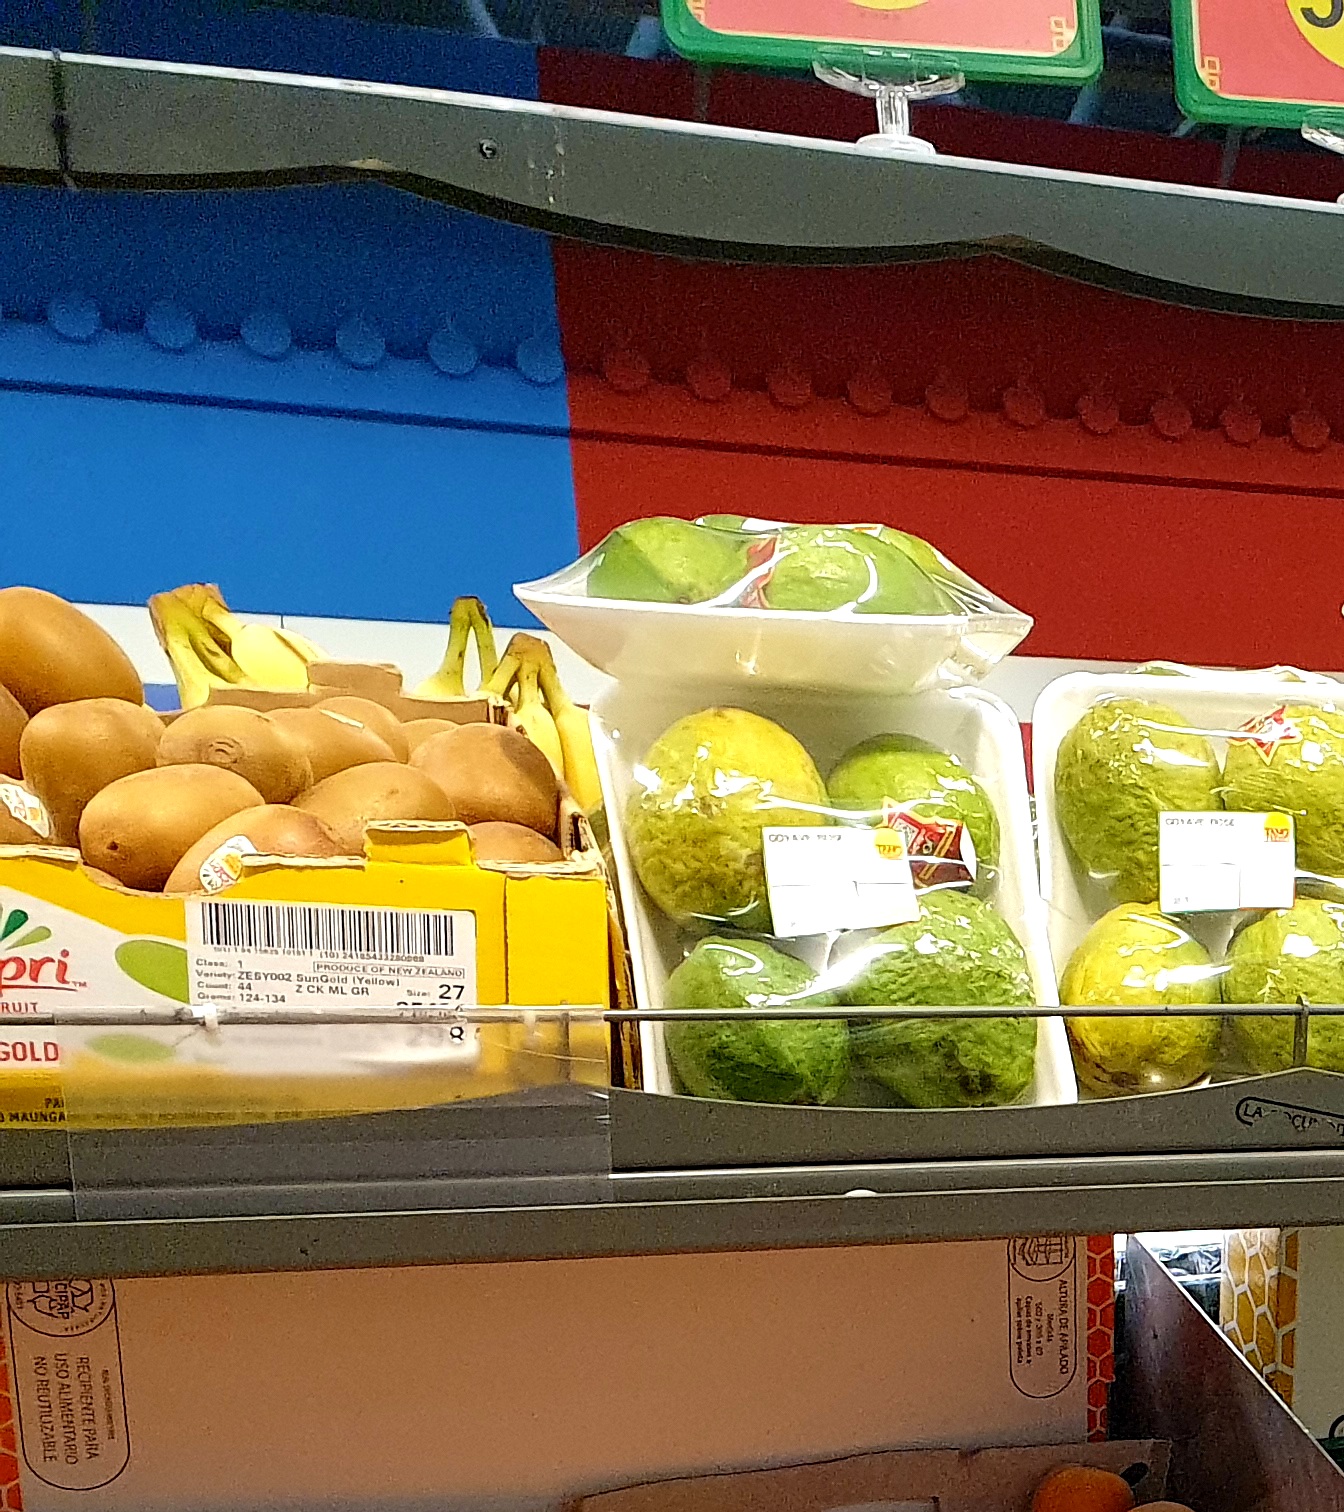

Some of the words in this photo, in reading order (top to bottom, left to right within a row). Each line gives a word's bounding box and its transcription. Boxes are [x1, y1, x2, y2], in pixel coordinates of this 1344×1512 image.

[316, 963, 367, 973] PRODUCE
[370, 965, 385, 973] OF
[388, 967, 413, 975] NEW
[415, 968, 463, 977] ZEALAND
[237, 982, 252, 991] 44
[306, 985, 325, 994] CK
[328, 986, 348, 995] ML
[351, 986, 370, 996] GR
[296, 973, 348, 985] SunGold
[352, 976, 400, 987] (Yellow)
[239, 993, 286, 1003] 124-134
[438, 984, 465, 1000] 27
[33, 1356, 49, 1376] NO
[54, 1352, 71, 1380] USO
[75, 1357, 96, 1425] RECIPIENTE
[36, 1379, 58, 1463] REUTILIZABLE
[57, 1382, 79, 1465] ALIMENTARIO
